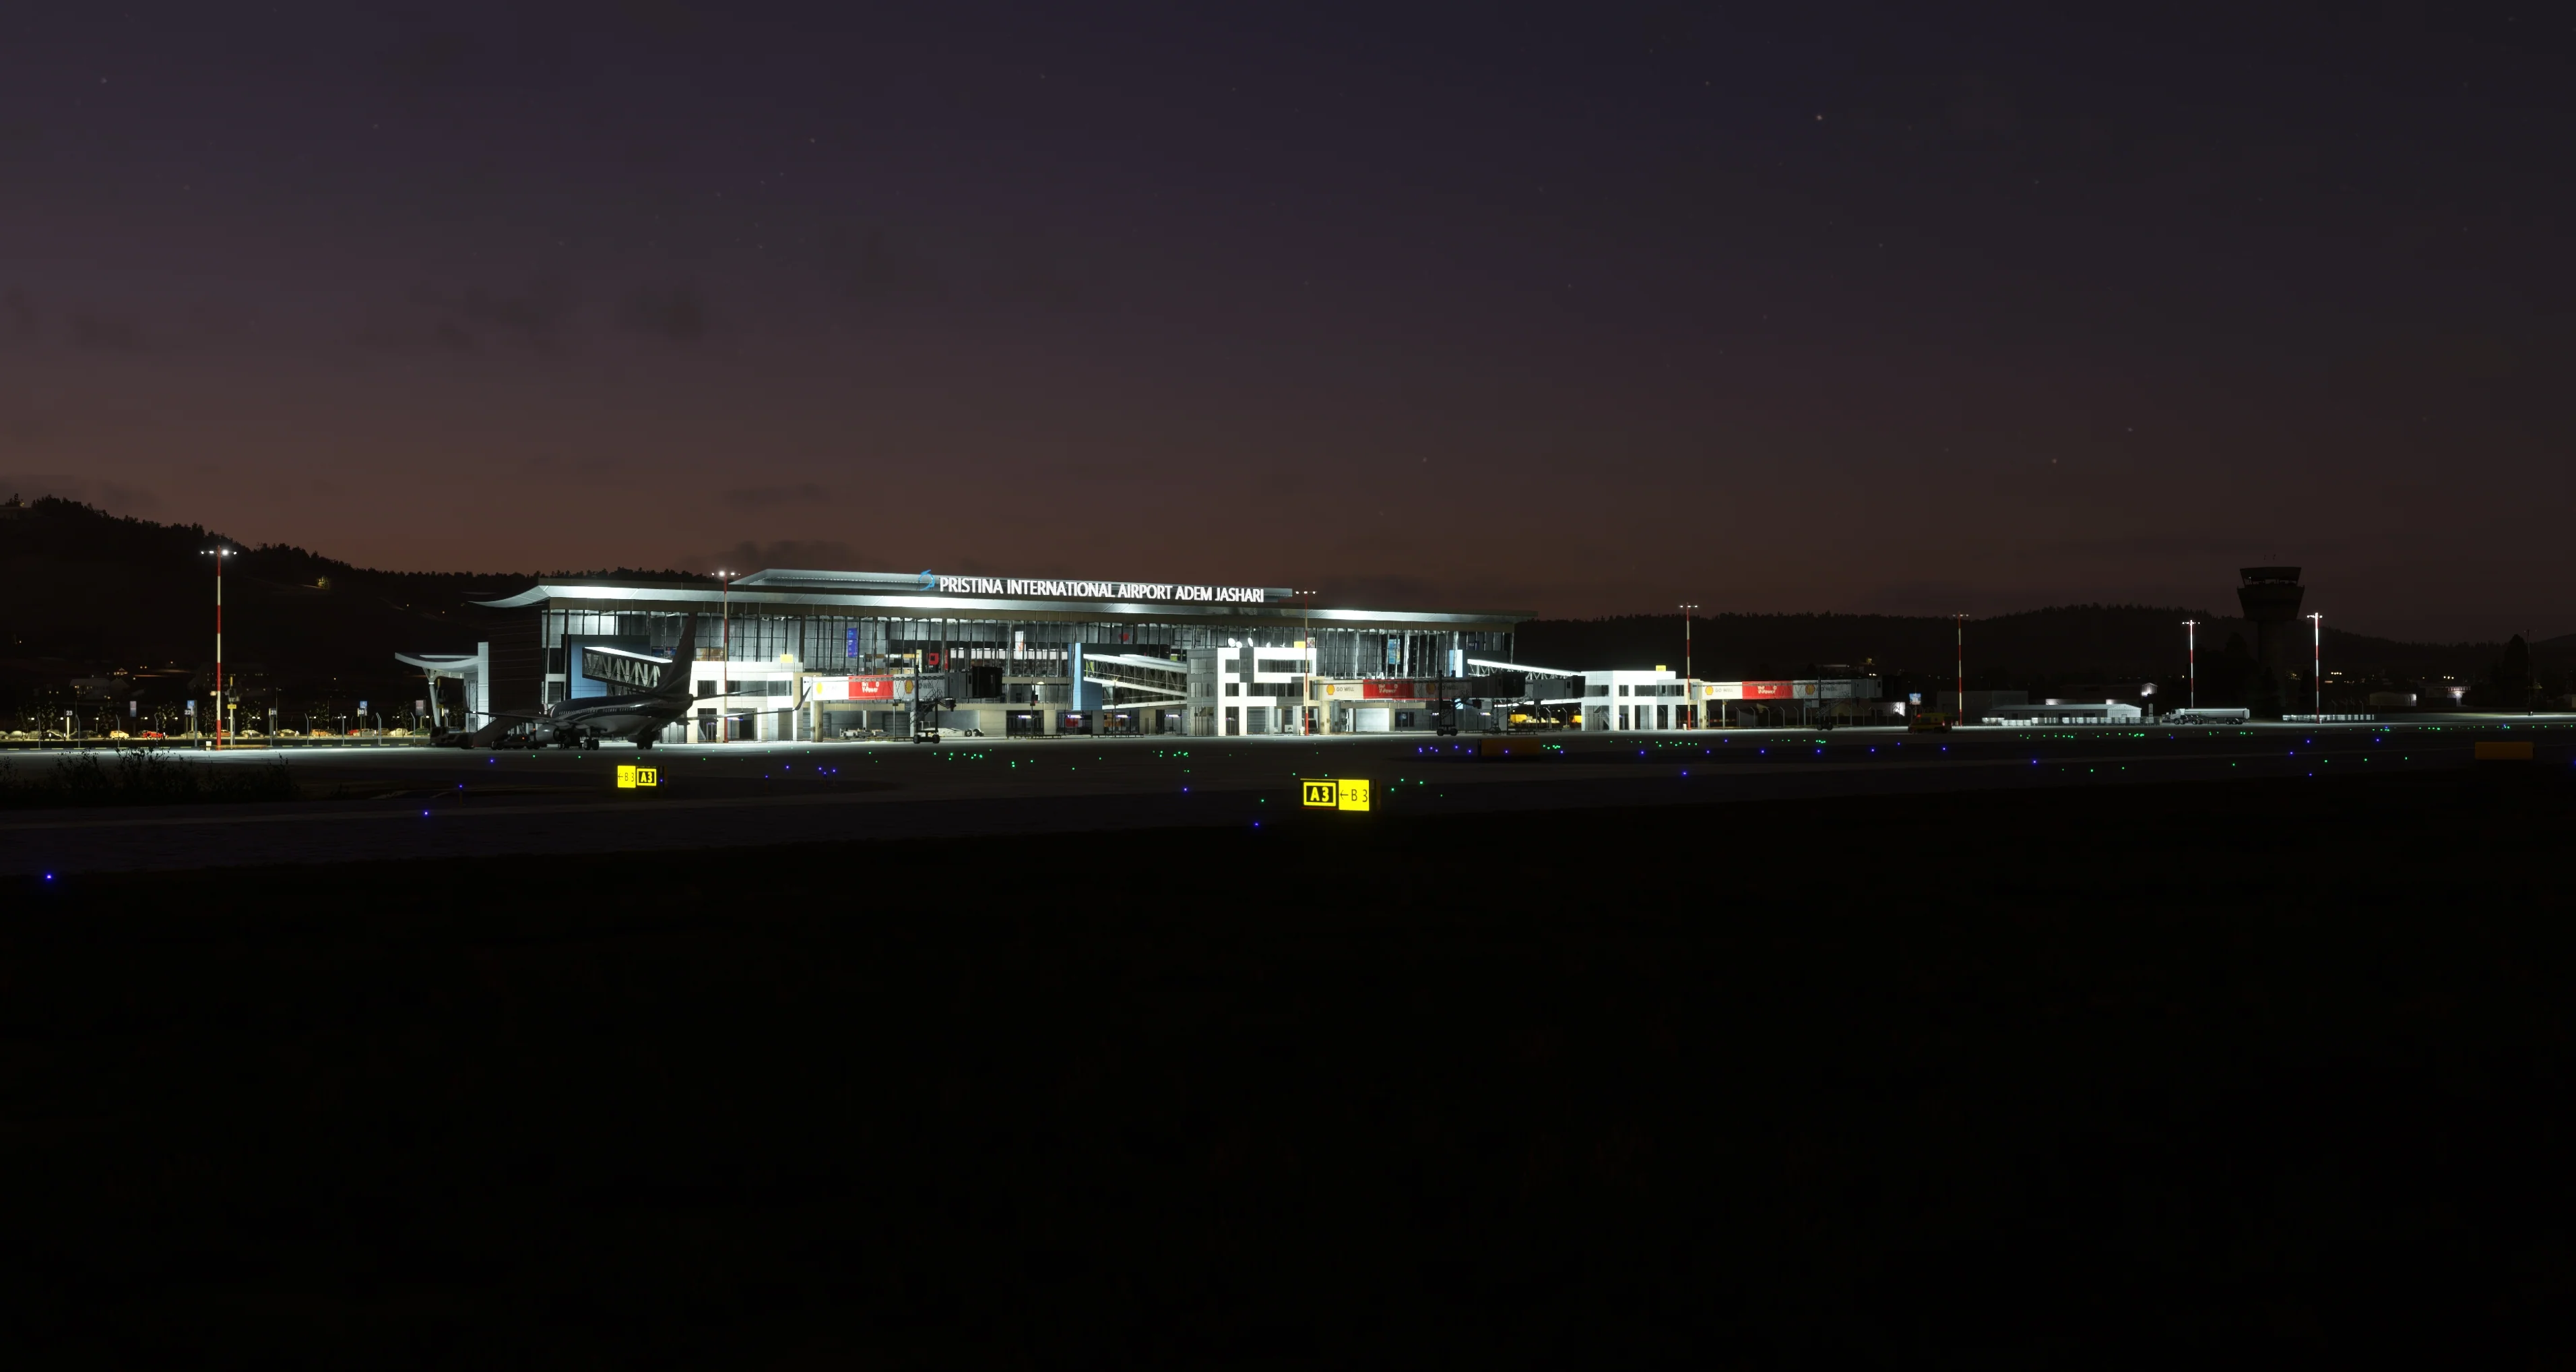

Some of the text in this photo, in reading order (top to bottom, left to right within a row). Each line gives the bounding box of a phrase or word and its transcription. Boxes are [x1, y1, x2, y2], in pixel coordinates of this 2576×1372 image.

[940, 577, 1264, 603] PRISTINA INTERNATIONAL AIRPORT ADEM JASHARI
[641, 772, 653, 783] A3
[1310, 786, 1330, 802] A3
